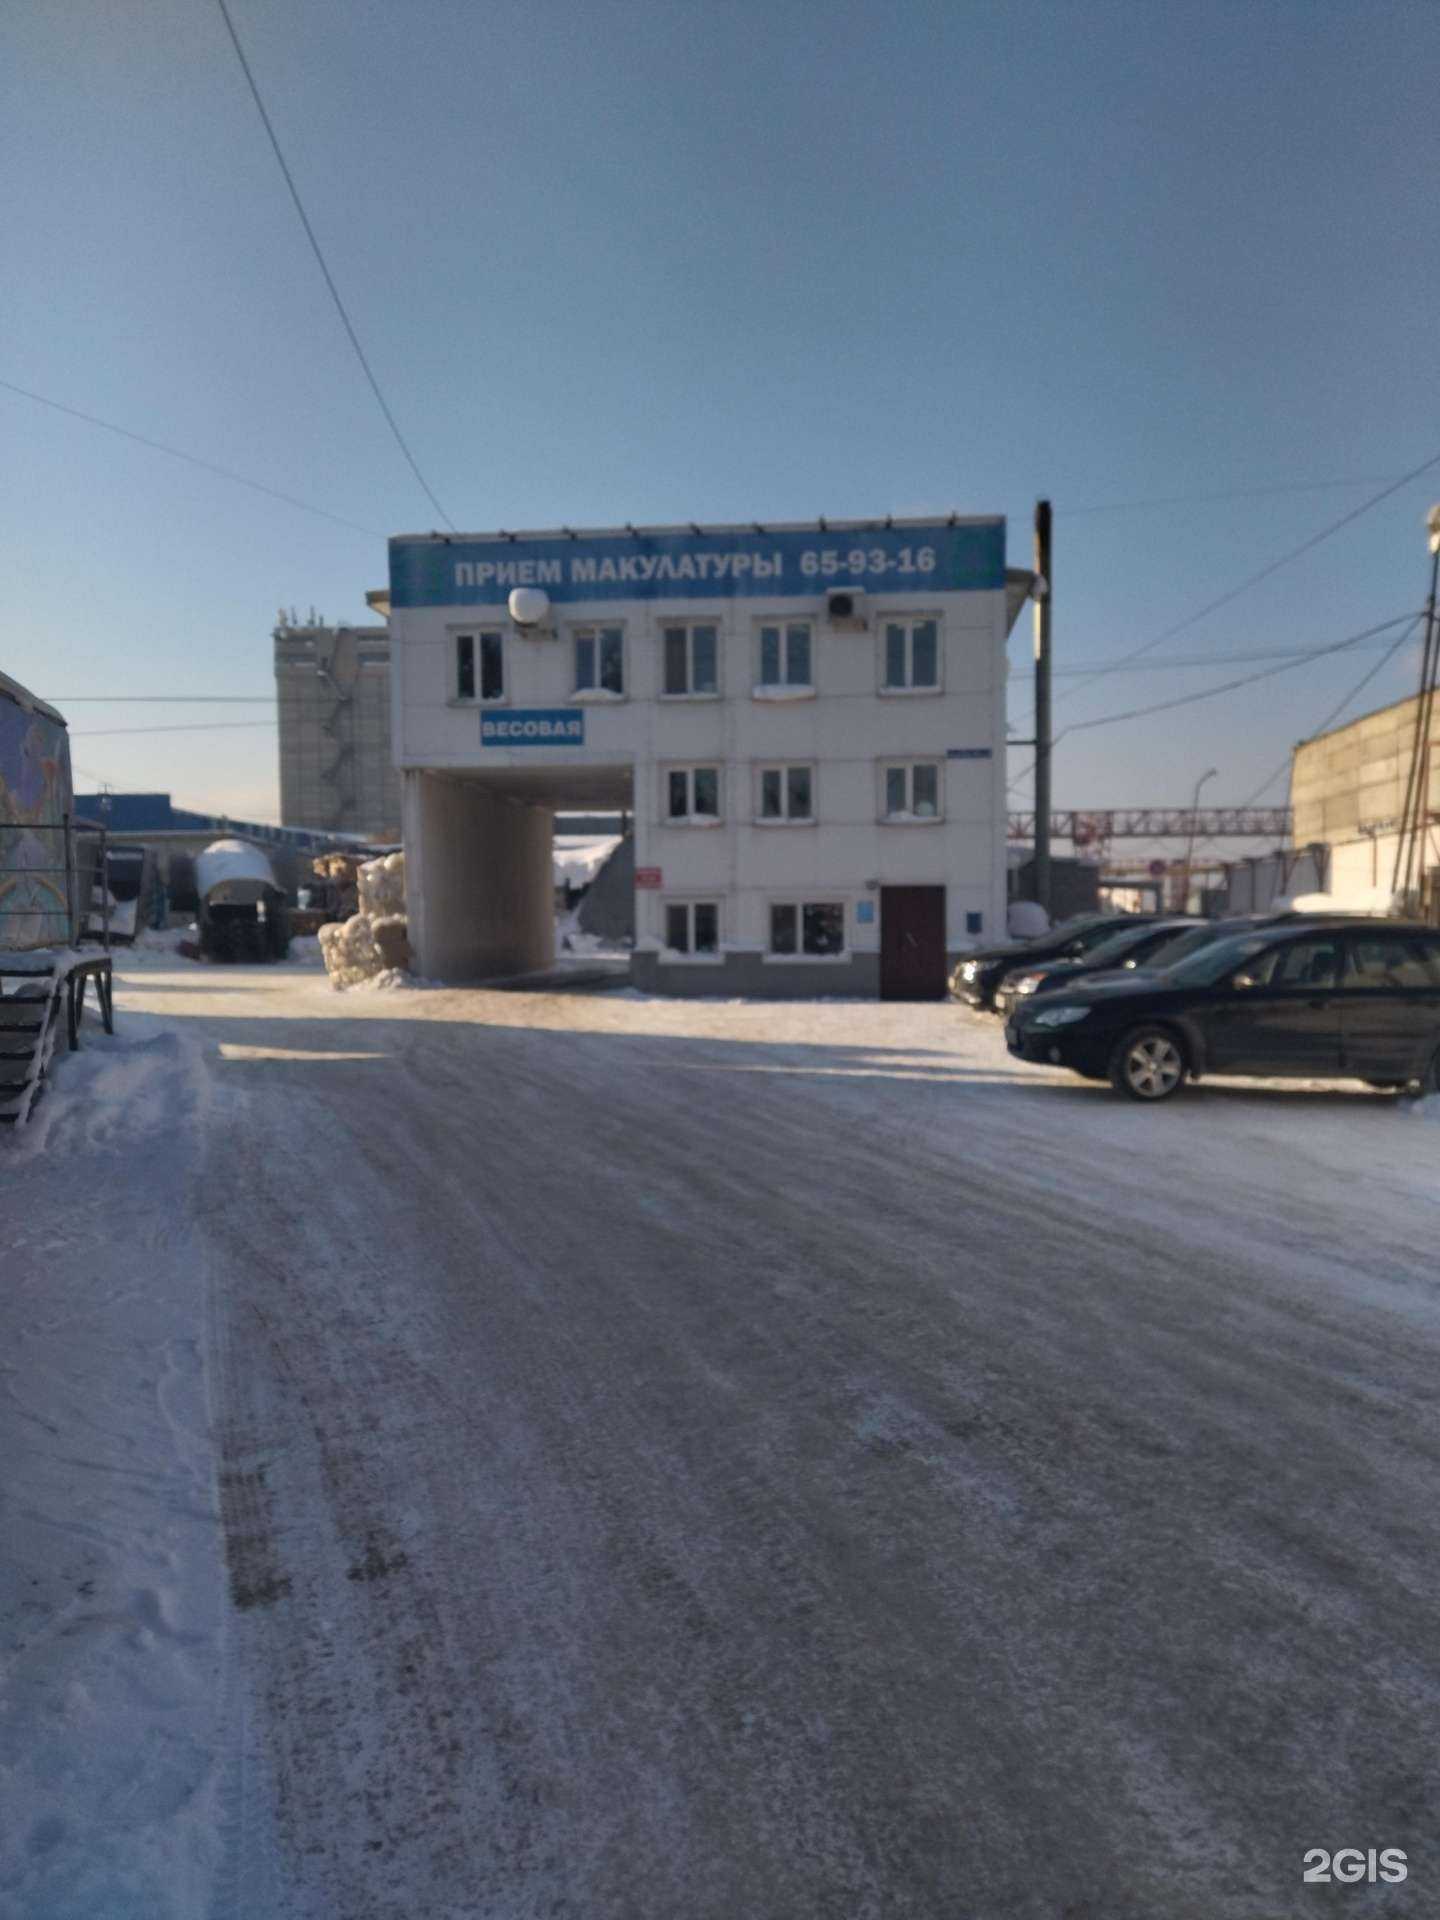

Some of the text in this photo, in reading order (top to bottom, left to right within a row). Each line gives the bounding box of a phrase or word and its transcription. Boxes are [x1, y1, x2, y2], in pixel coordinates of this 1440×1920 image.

[454, 546, 937, 588] ПРИЕМ МАКУЛАТУРЫ 65-93-16
[482, 720, 581, 738] ВЕСОВАЯ
